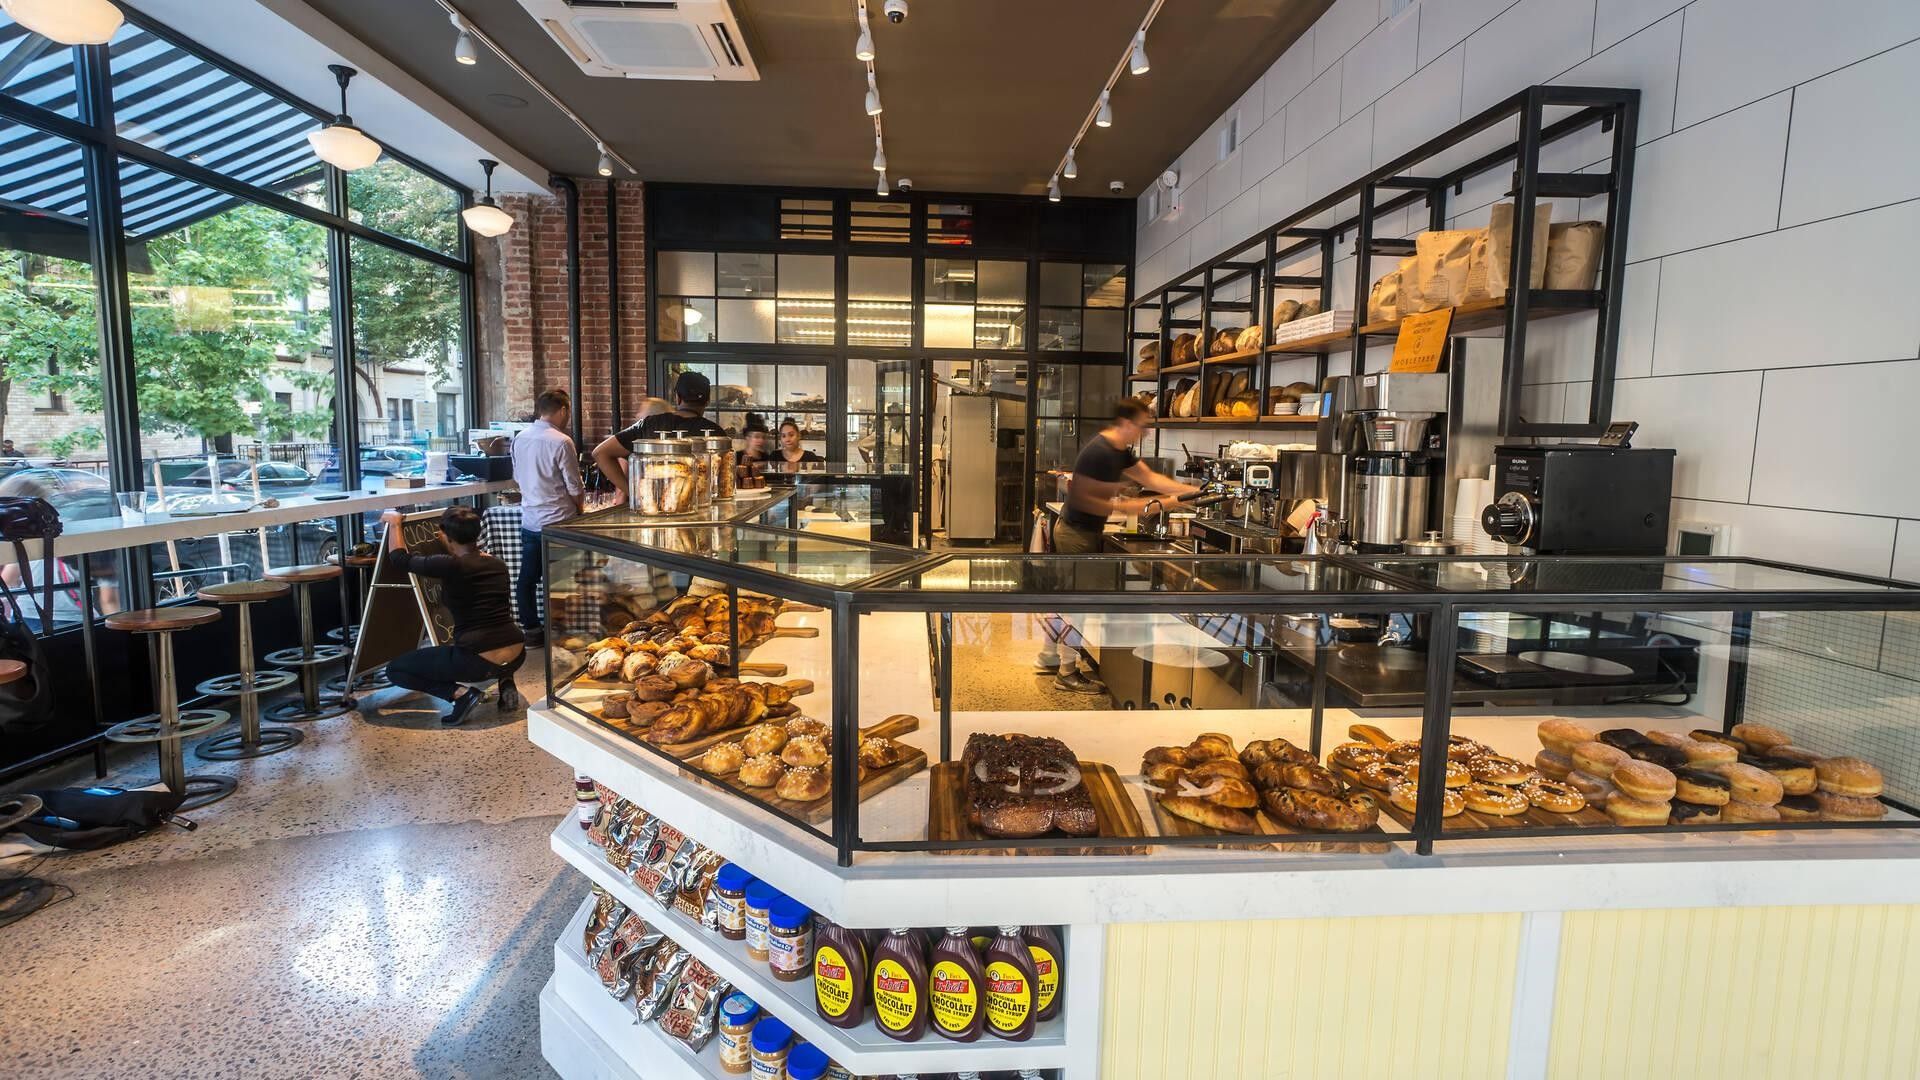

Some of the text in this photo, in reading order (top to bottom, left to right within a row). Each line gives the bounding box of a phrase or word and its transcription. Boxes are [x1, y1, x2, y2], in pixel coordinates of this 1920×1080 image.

[661, 826, 682, 842] ORK
[817, 979, 849, 1000] CHOCOLATE
[822, 977, 840, 989] ORIGINAL
[819, 988, 832, 1000] FLAVOR
[832, 994, 846, 1004] SYRUP
[876, 992, 912, 1013] CHOCOLATE
[883, 991, 903, 1001] ORIGINAL
[932, 994, 973, 1013] CHOCOLATE
[940, 993, 963, 1003] ORIGINAL
[992, 993, 1016, 1003] ORIGINAL
[878, 1002, 893, 1012] FLAVOR
[894, 1009, 909, 1018] SYRUP
[934, 1004, 952, 1014] FLAVOR
[952, 1010, 969, 1018] SYRUP
[1006, 1009, 1022, 1017] SYRUP
